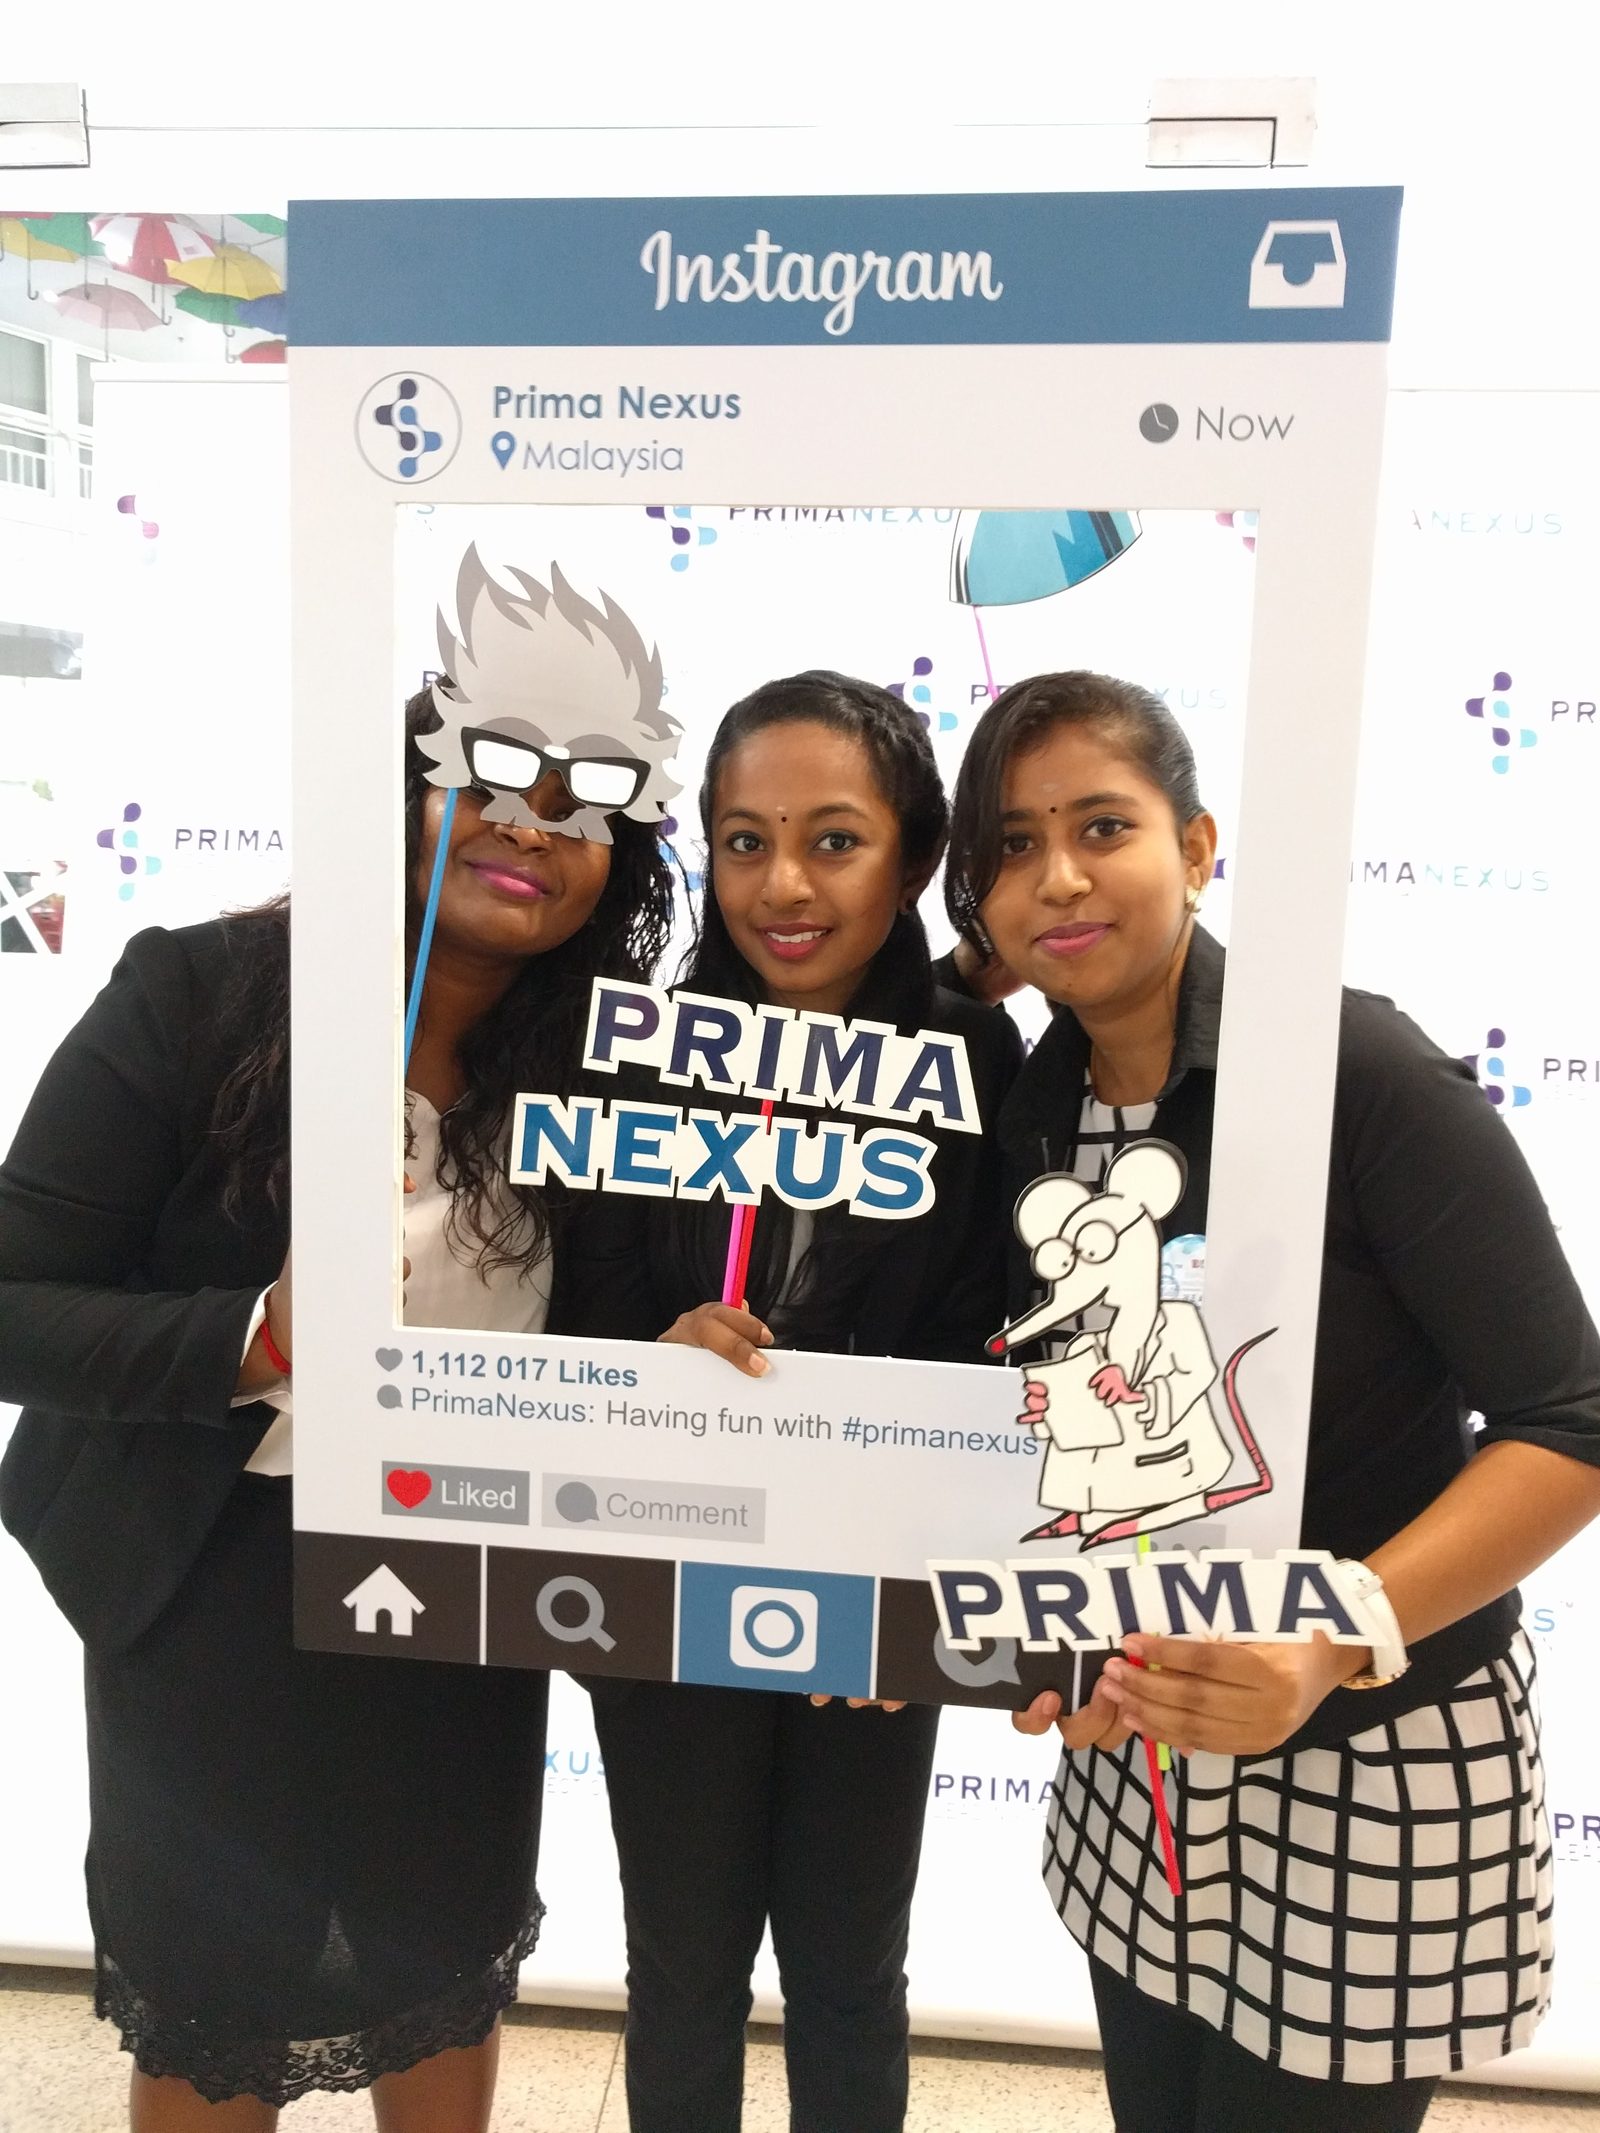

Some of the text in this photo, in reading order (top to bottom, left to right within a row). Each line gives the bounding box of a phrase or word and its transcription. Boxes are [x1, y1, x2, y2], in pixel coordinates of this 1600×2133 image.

[640, 229, 1004, 336] Instagram
[493, 385, 741, 419] Prima Nexus
[1196, 406, 1295, 441] Now
[523, 440, 684, 477] Malaysia
[175, 828, 284, 851] PRIMA
[589, 987, 966, 1122] PRIMA
[517, 1102, 927, 1211] NEXUS
[412, 1350, 638, 1387] 1,112 017 Likes
[411, 1387, 1038, 1456] PrimaNexus: Having fun with #primanexus
[441, 1479, 517, 1510] Liked
[606, 1491, 749, 1527] Comment
[933, 1560, 1366, 1642] PRIMA
